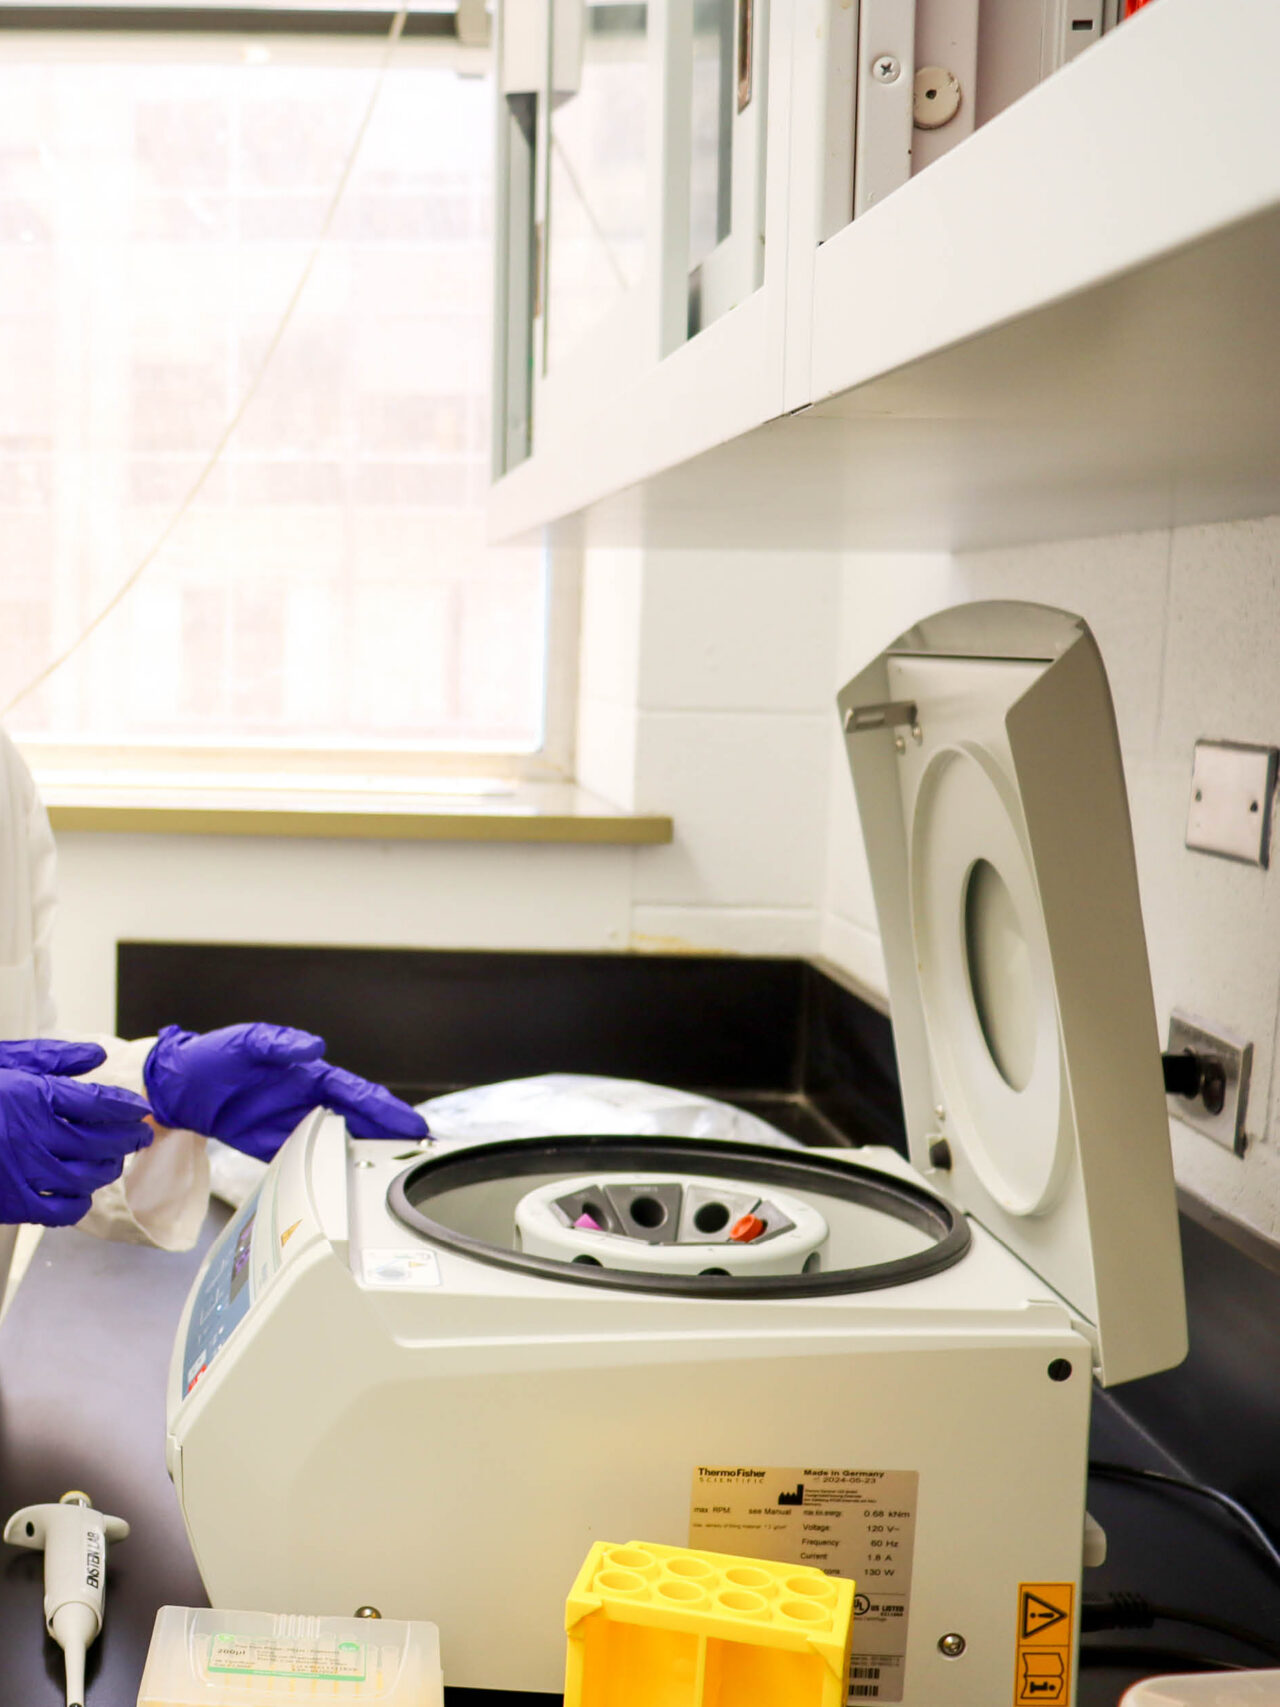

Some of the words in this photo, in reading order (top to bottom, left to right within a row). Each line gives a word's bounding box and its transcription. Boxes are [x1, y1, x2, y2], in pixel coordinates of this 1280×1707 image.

[842, 1470, 885, 1478] Germany
[867, 1525, 883, 1533] 120
[886, 1540, 899, 1548] Hz
[884, 1554, 893, 1562] A
[864, 1568, 881, 1576] 130
